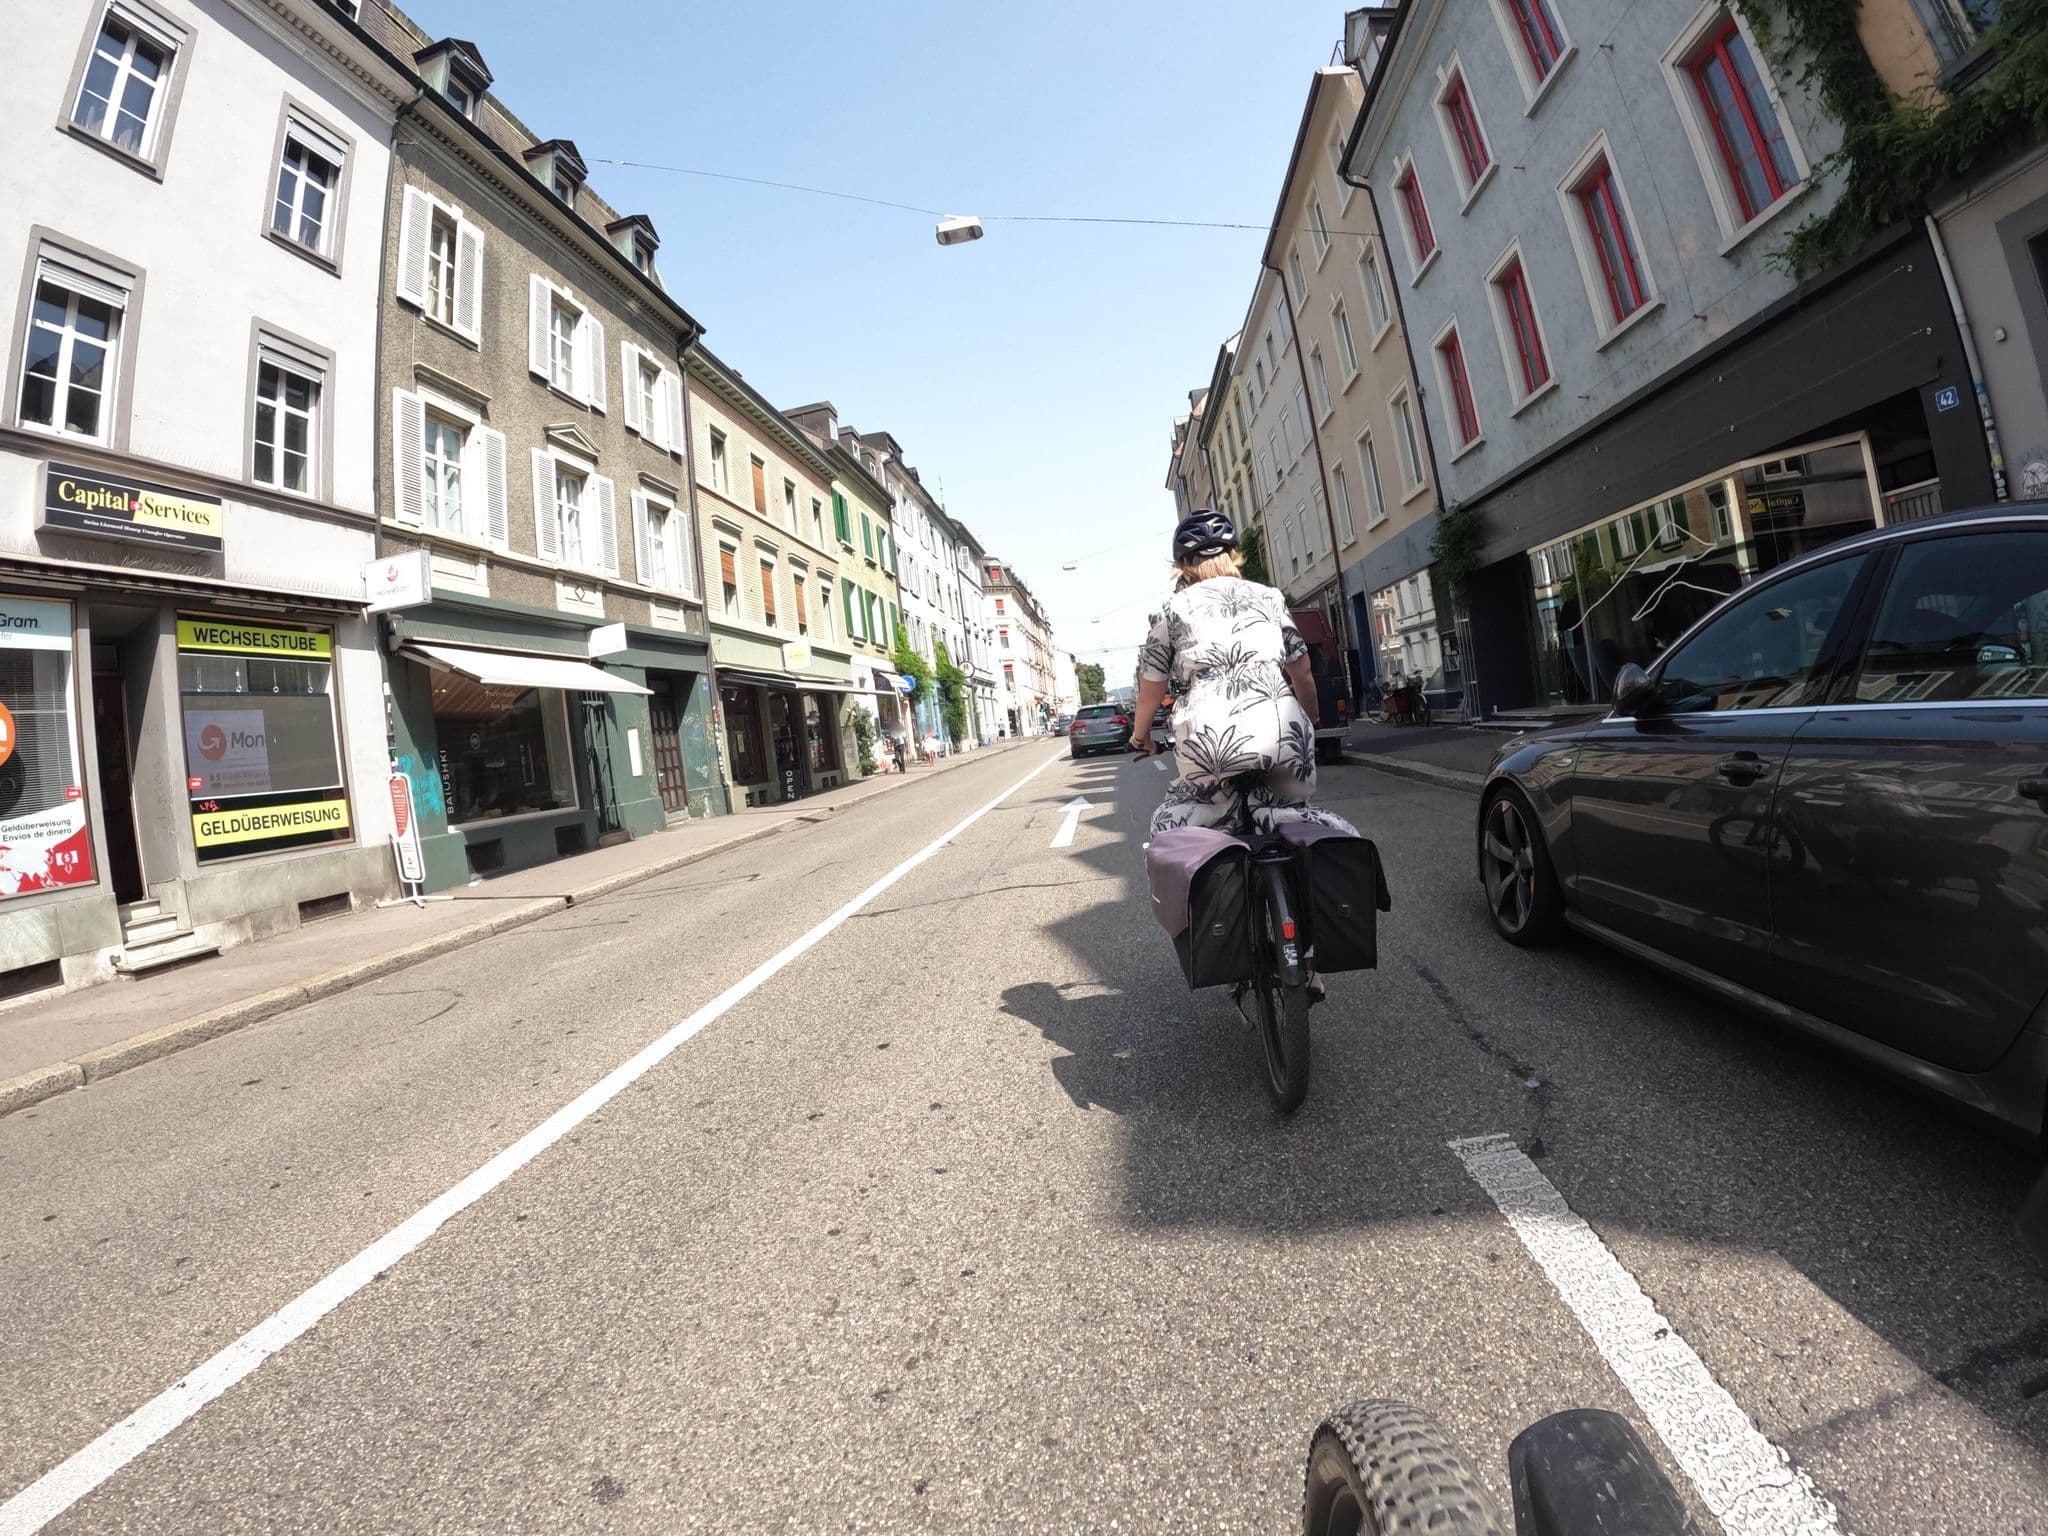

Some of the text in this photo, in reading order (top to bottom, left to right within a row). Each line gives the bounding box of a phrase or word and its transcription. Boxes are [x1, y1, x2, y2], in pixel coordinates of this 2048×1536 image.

[1940, 391, 1954, 406] 42
[58, 480, 211, 526] Capital Services
[124, 525, 141, 534] Money
[193, 626, 317, 651] WECHSELSTUBE
[785, 770, 795, 800] OPEN
[1, 818, 71, 833] Geldüberweisung
[200, 807, 341, 837] GELDÜBERWEISUNG
[34, 831, 44, 839] de
[47, 827, 72, 837] dinero
